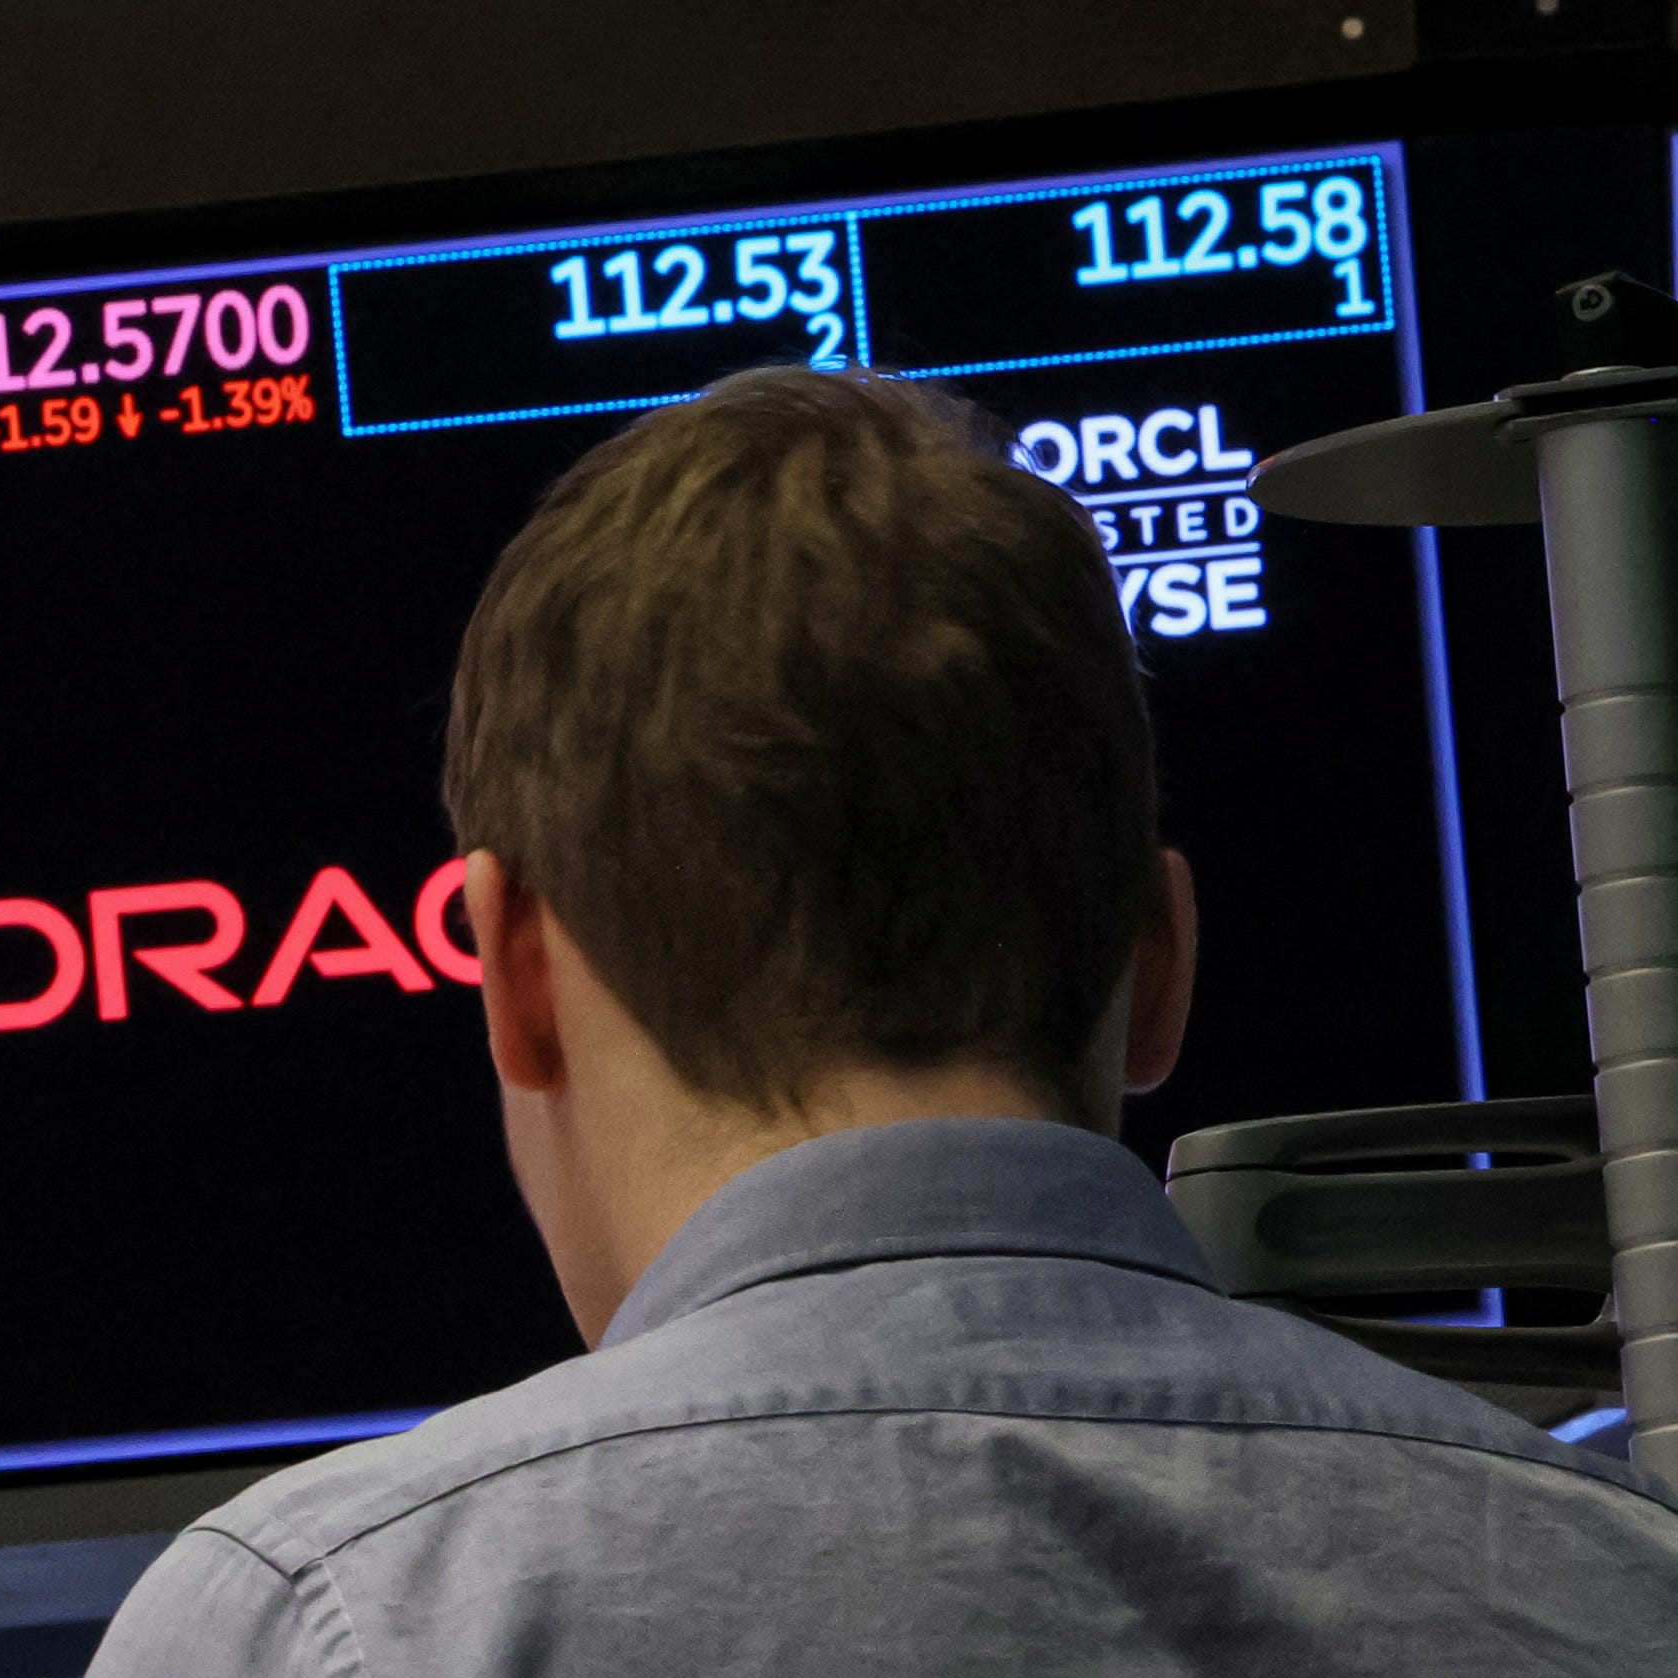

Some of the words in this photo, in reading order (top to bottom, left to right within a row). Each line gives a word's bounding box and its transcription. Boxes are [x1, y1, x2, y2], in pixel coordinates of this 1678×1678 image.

[1072, 176, 1368, 286] 112.58
[550, 231, 840, 340] 112.53
[1333, 257, 1374, 317] 1
[806, 312, 847, 371] 2
[160, 374, 314, 433] -1.39%
[1012, 404, 1253, 486] ORCL
[1092, 497, 1260, 551] STED
[1120, 558, 1267, 636] YSE
